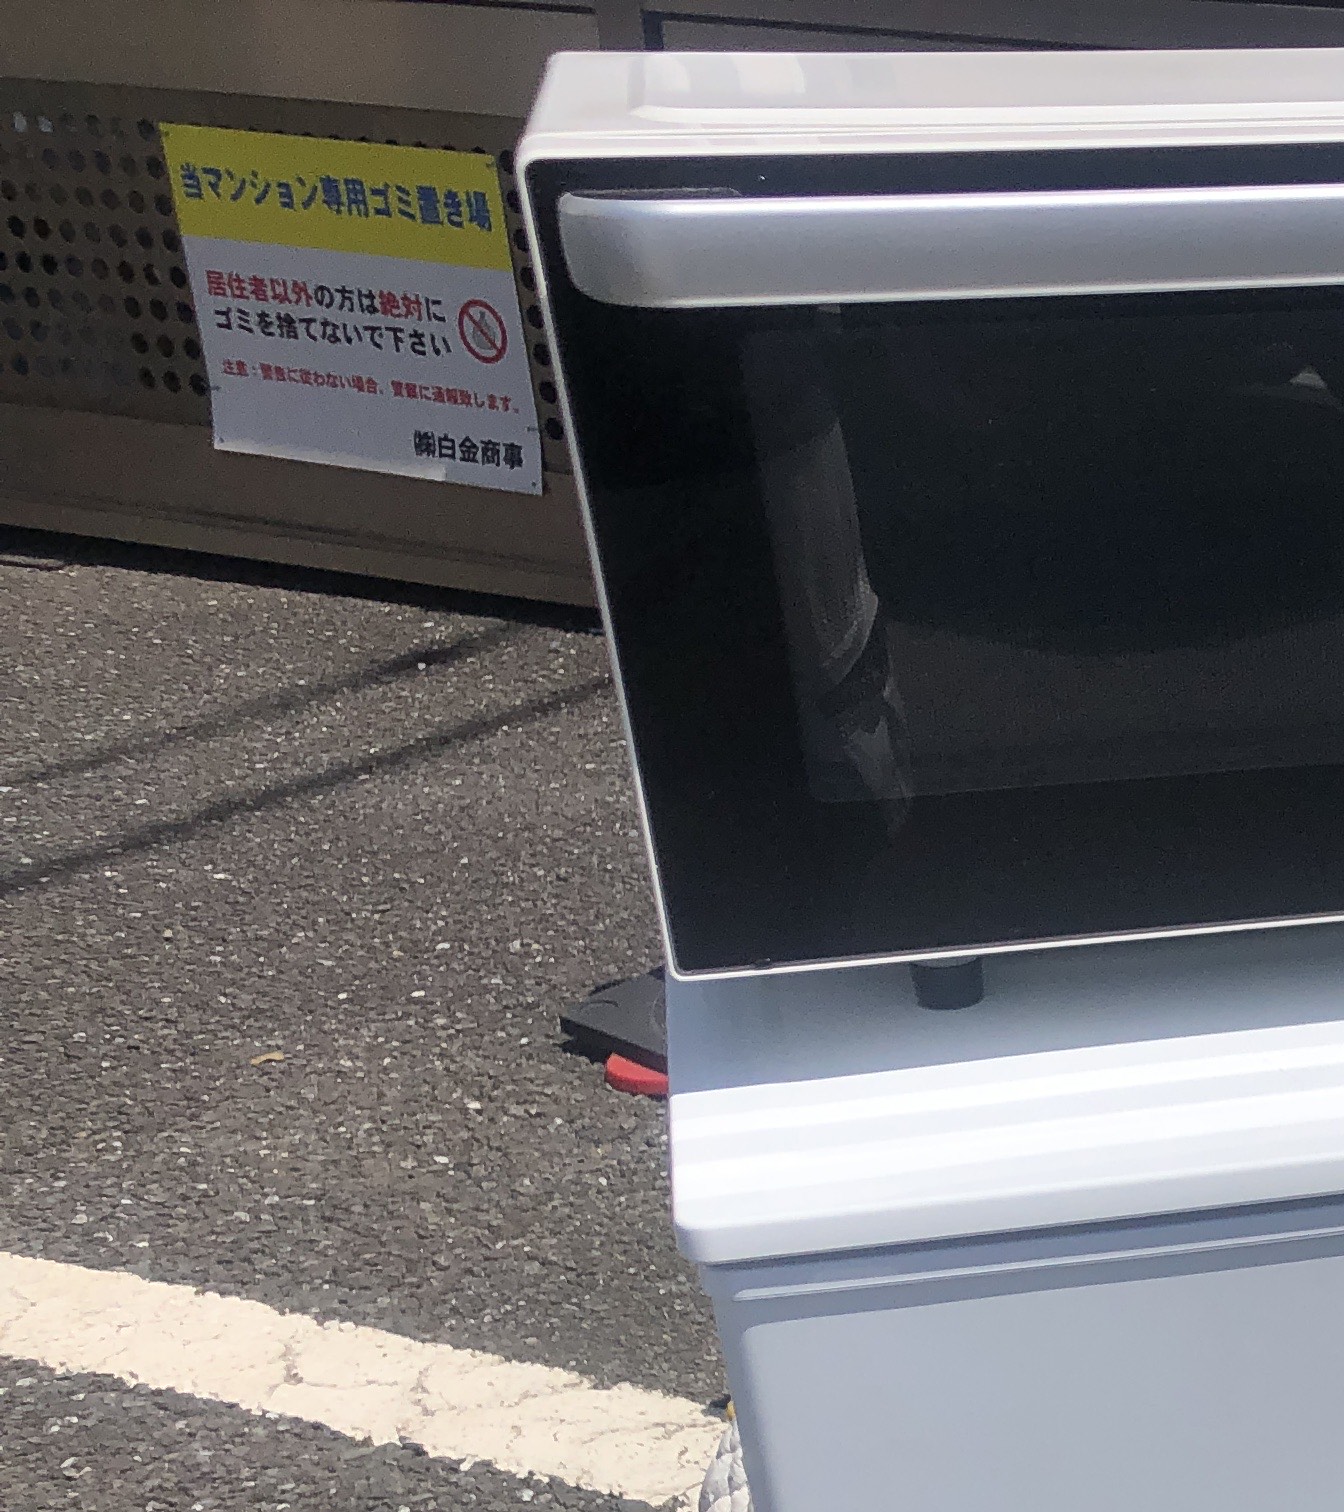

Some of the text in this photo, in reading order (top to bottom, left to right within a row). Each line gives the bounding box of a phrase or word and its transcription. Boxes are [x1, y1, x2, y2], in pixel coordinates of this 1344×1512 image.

[179, 162, 492, 232] 当マンション専用ゴミ置き場
[206, 269, 446, 324] 居住者以外の方は絶対に
[214, 307, 452, 358] ゴミを捨てないで下さい
